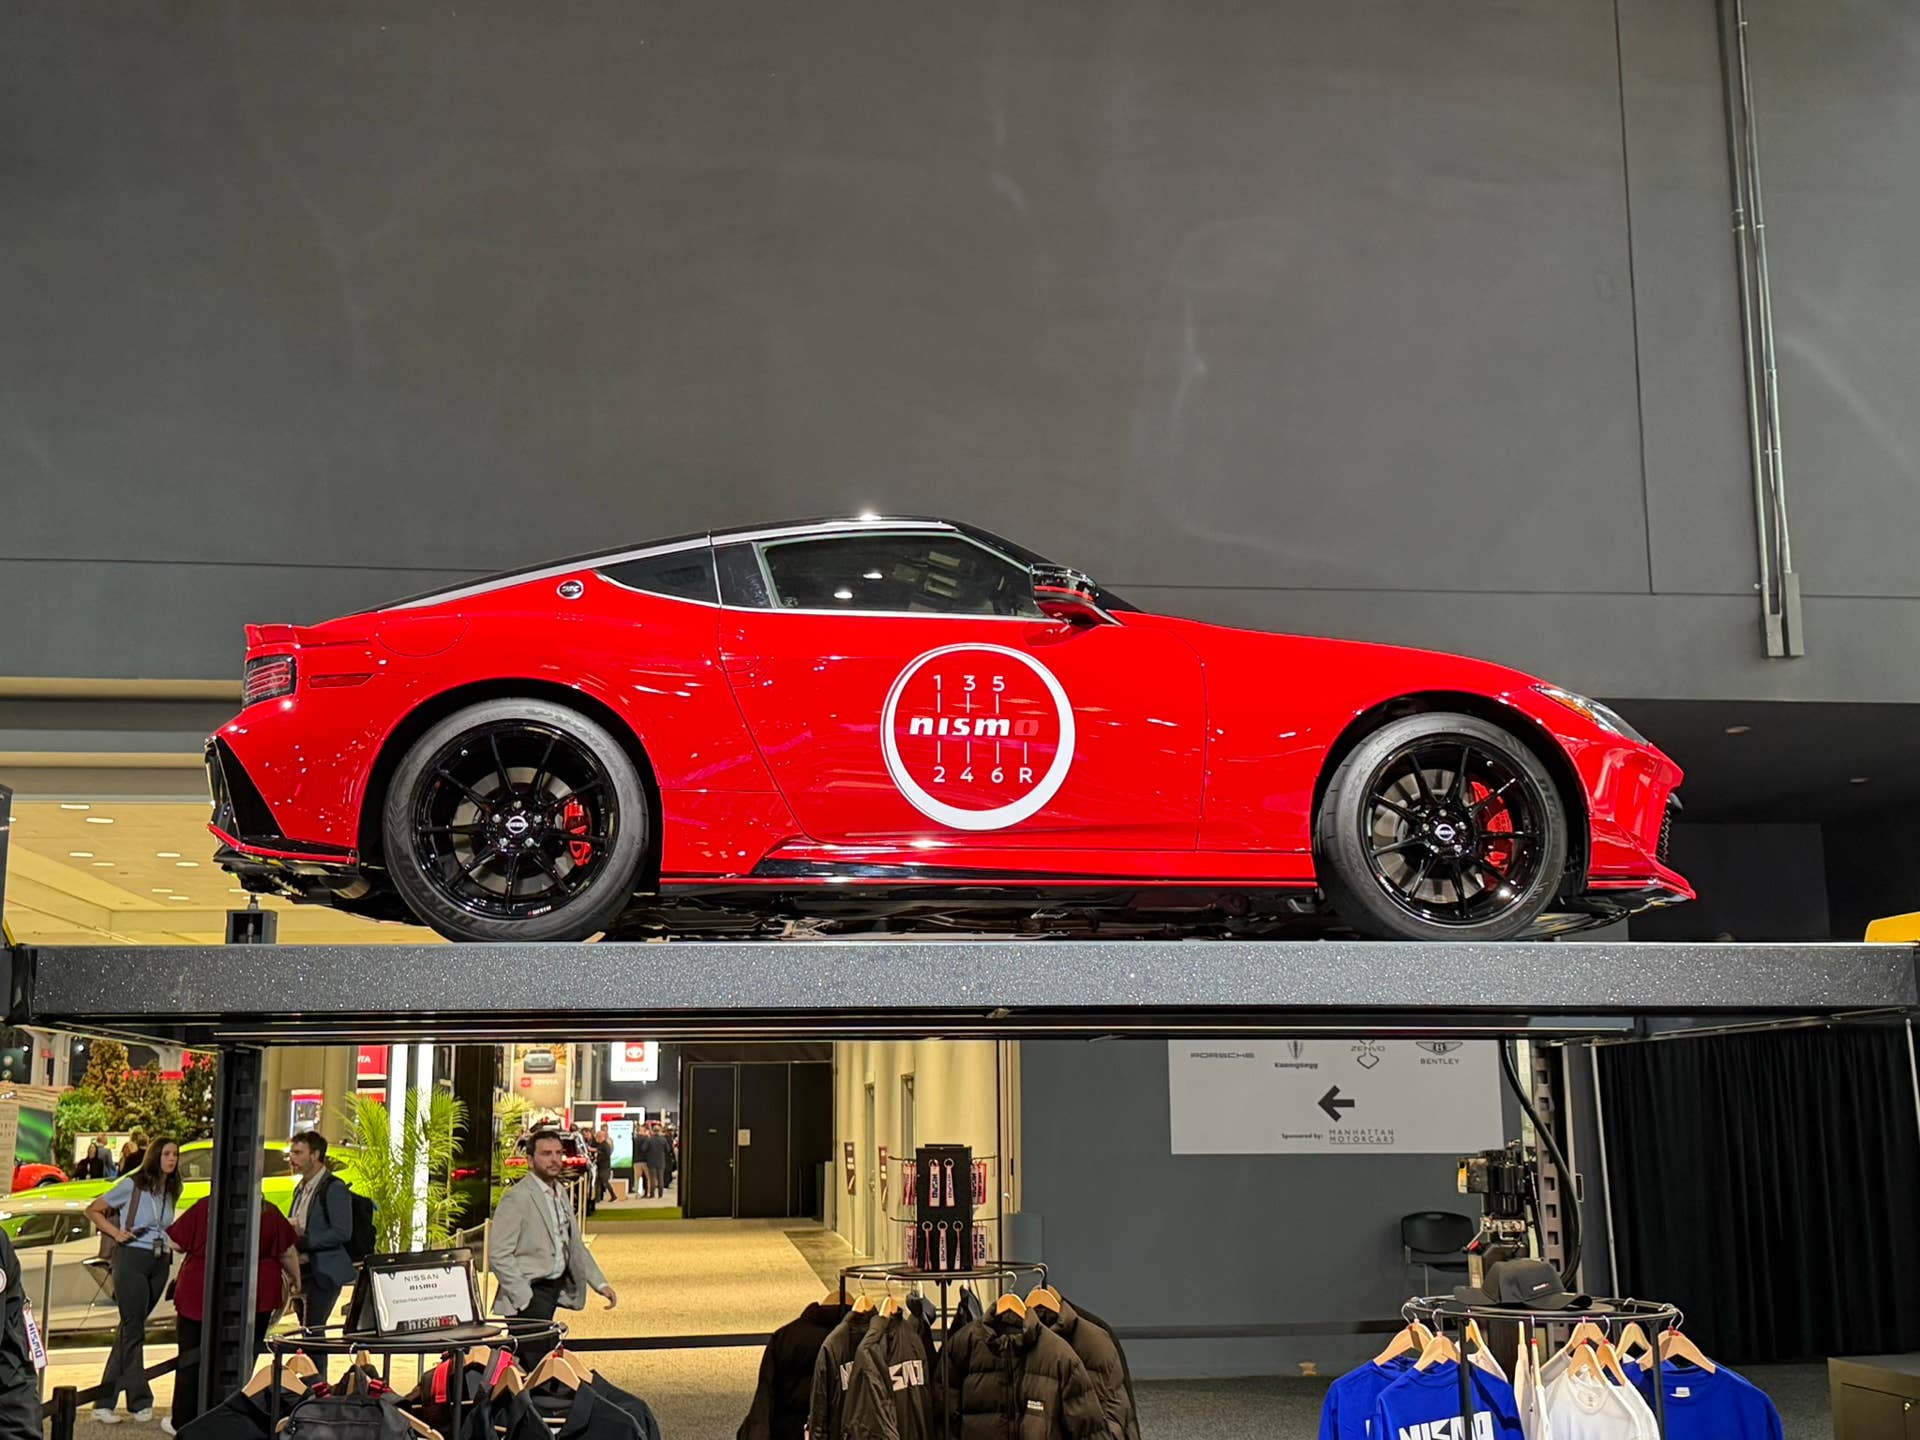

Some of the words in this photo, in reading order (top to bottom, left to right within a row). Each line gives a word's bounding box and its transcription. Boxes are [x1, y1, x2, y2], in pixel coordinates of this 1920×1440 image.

[933, 675, 942, 690] 1
[963, 675, 976, 691] 3
[992, 676, 1005, 691] 5
[909, 717, 1039, 736] nismo
[933, 766, 945, 782] 2
[960, 766, 974, 782] 4
[991, 767, 1004, 783] 6
[1019, 768, 1033, 783] R
[404, 1274, 439, 1282] NISSAN
[28, 1323, 43, 1358] NISMO
